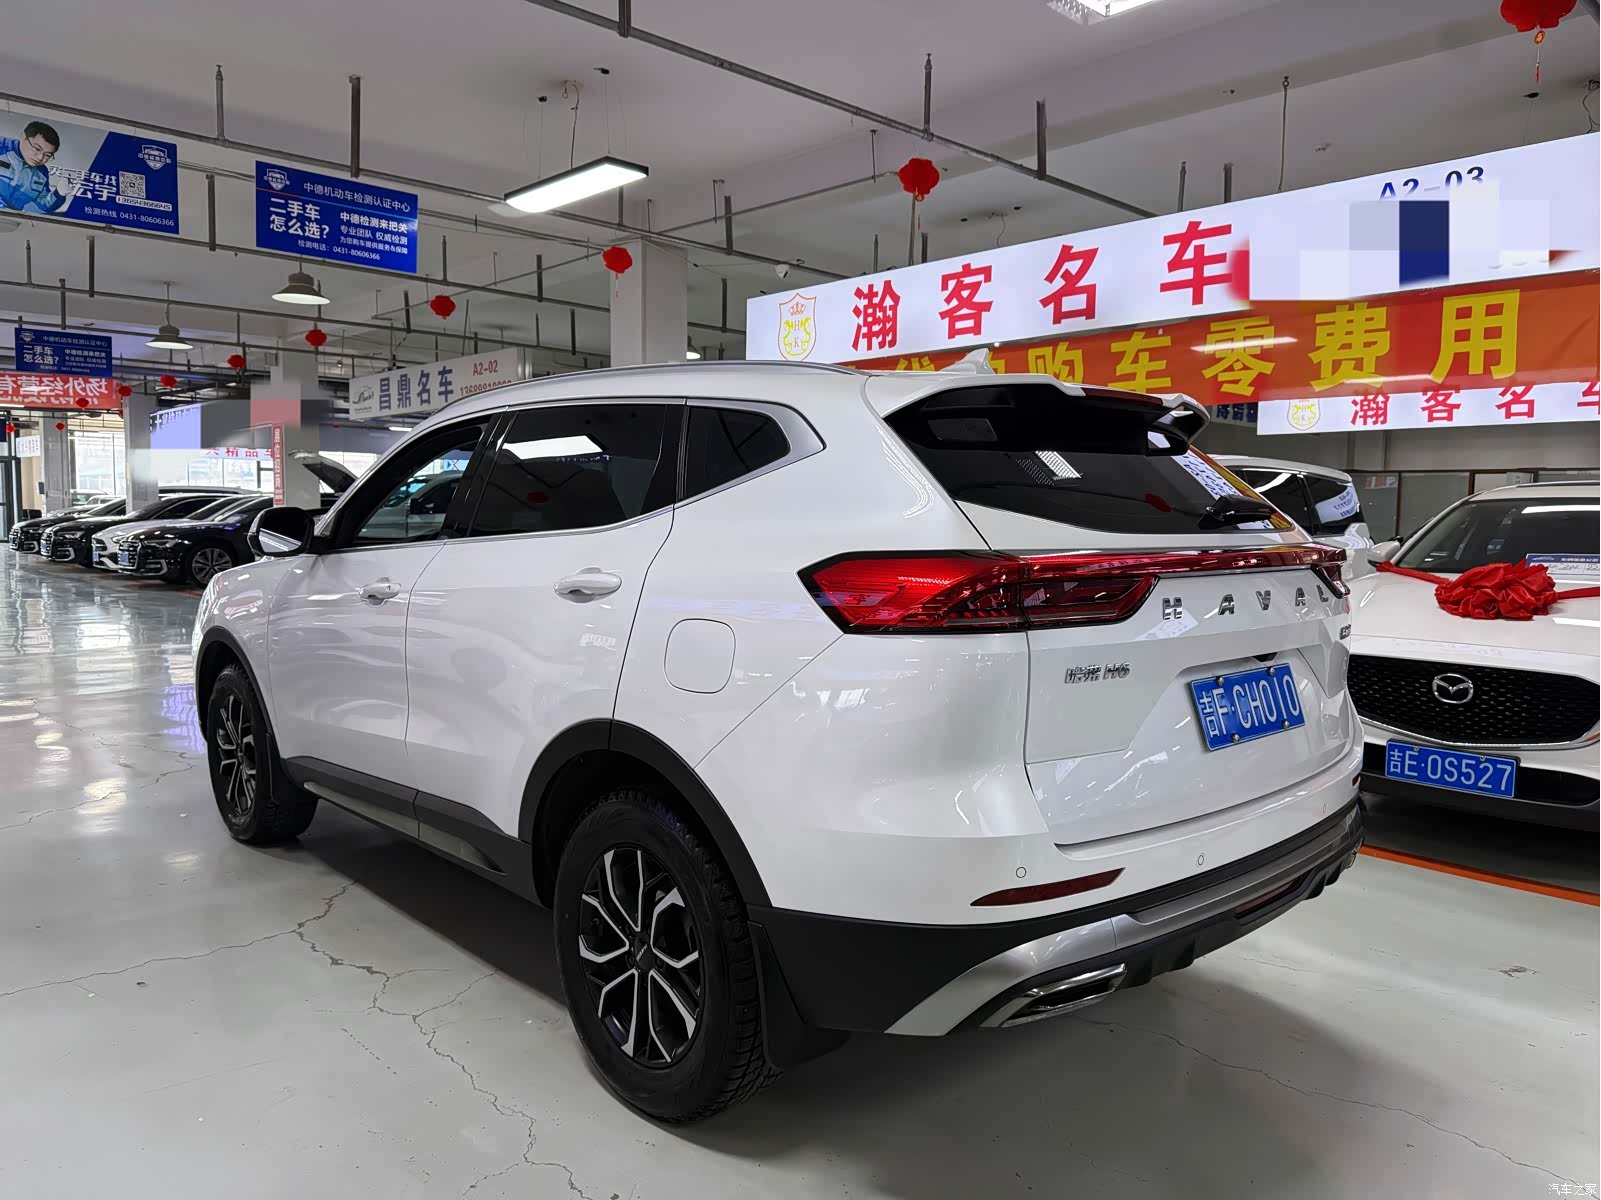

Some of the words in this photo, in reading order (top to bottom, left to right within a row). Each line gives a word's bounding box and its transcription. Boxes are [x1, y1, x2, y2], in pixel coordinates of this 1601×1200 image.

[71, 180, 117, 202] 宏宇
[303, 181, 411, 213] 中德机动车检测认证中心
[84, 206, 118, 219] 检测热线
[119, 212, 175, 227] 0431-80606366
[269, 197, 321, 221] 二手车
[269, 214, 330, 239] 怎么选？
[340, 211, 409, 234] 中德检测来把关
[340, 225, 374, 239] 专业团队
[375, 230, 409, 245] 权威检测
[333, 246, 381, 261] 0431-80606366
[851, 220, 1233, 353] 瀚客名车
[23, 345, 54, 356] 二手车
[472, 359, 499, 376] A2-02
[378, 365, 454, 412] 昌鼎名车
[1162, 584, 1330, 621] HAVAL
[1102, 662, 1131, 680] H6
